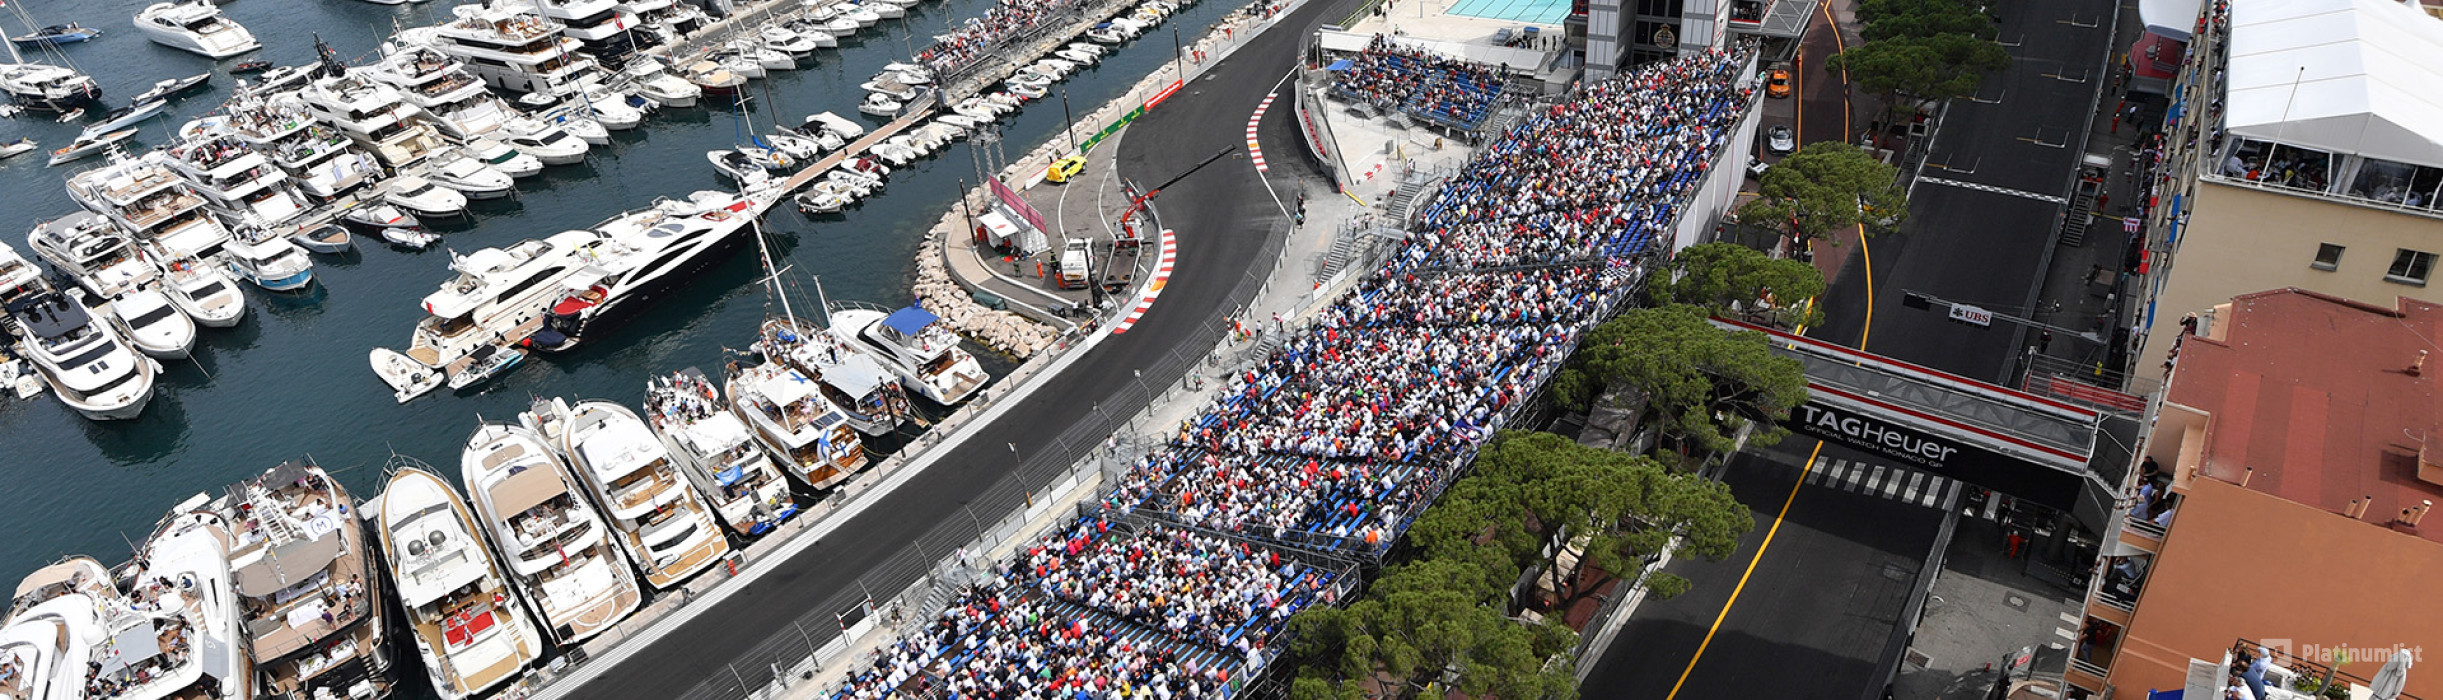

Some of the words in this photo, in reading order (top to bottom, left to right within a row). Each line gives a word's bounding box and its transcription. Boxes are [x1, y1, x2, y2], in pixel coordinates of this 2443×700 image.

[1965, 310, 1990, 323] UBS
[1804, 424, 1844, 441] OFFICIAL
[1847, 437, 1880, 451] WATCH
[1883, 447, 1926, 464] MONACO
[1928, 460, 1943, 468] GP
